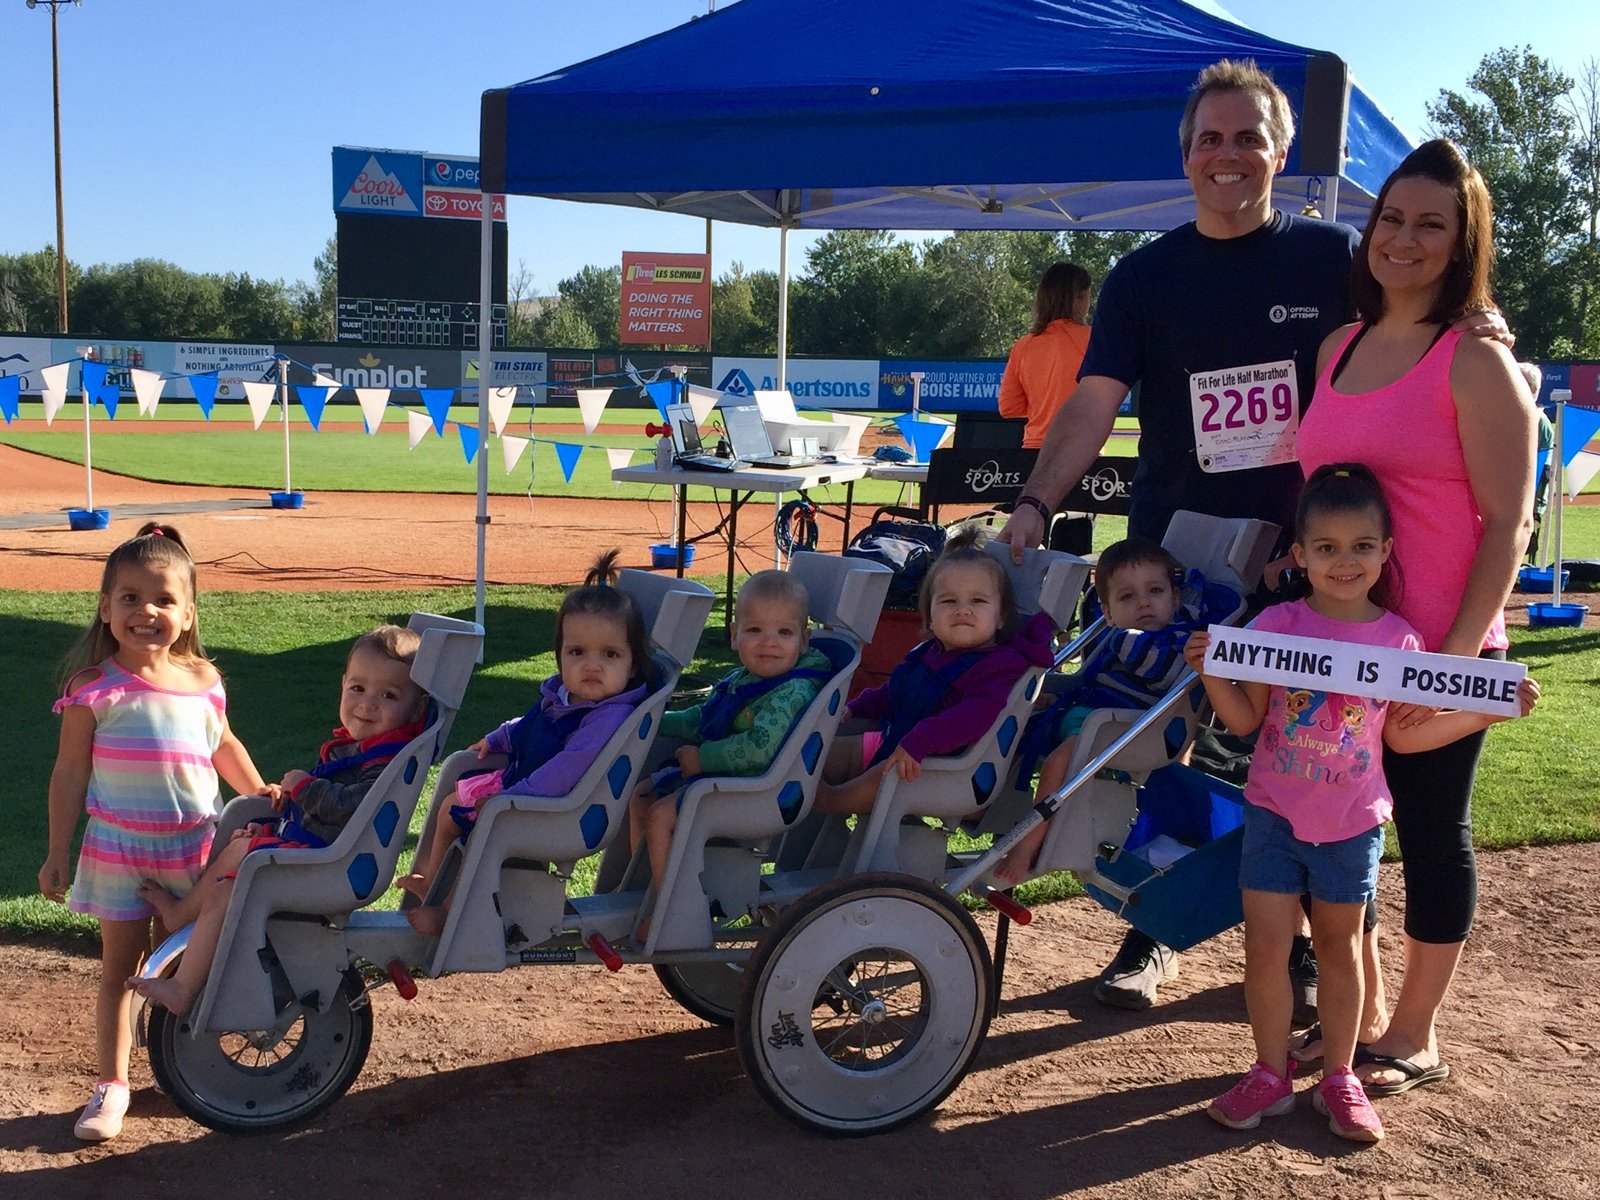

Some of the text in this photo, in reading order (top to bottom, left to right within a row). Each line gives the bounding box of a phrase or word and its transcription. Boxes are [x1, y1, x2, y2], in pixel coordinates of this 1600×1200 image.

[351, 172, 406, 196] Coors
[361, 195, 396, 207] LIGHT
[450, 198, 504, 213] TOYOA
[636, 266, 653, 278] Tires
[656, 270, 702, 280] LES SCHWAB
[628, 293, 693, 304] DOING THE
[628, 307, 703, 319] RIGHT THING
[341, 321, 362, 329] GUEST
[628, 322, 684, 333] MATTERS.
[338, 332, 363, 340] HAWKS
[180, 346, 269, 356] 6 SIMPLE INGREDIENTS
[185, 362, 265, 372] NOTHING ARTIFICIAL
[494, 361, 544, 372] TRI STATE
[880, 372, 914, 385] HAWK
[923, 371, 947, 383] ROUD
[949, 372, 985, 383] PARTNER
[986, 373, 997, 383] OF
[1197, 367, 1289, 390] Fit For Life Half Marathon
[1546, 373, 1562, 381] first
[761, 376, 871, 398] Alertsons
[920, 383, 960, 397] BOISE
[1199, 383, 1292, 432] 2269
[964, 472, 1020, 484] SPORTS
[1211, 640, 1518, 703] ANYTHING IS POSSIBLE
[1287, 734, 1339, 757] Always
[1271, 746, 1347, 785] Shine
